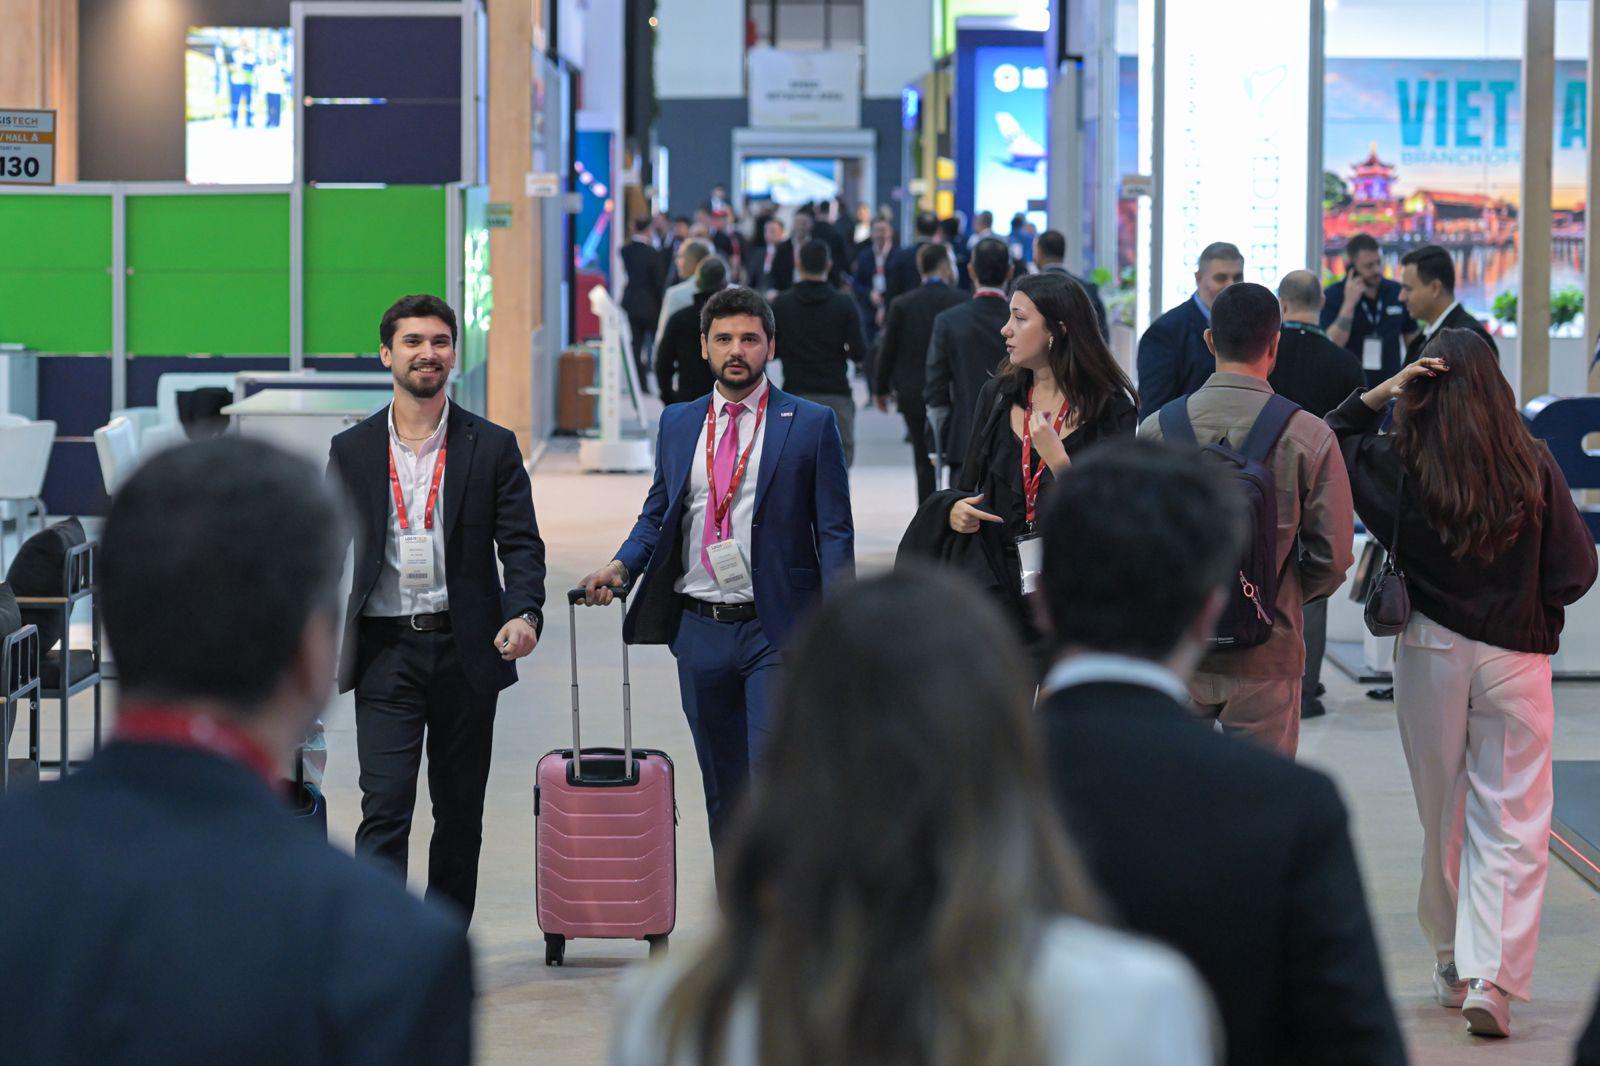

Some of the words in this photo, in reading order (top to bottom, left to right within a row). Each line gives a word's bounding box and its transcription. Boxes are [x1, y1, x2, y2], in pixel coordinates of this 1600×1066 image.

[0, 116, 39, 125] ISTECH
[5, 133, 29, 142] HALL
[31, 133, 39, 142] A
[1251, 131, 1279, 284] YEDITEP
